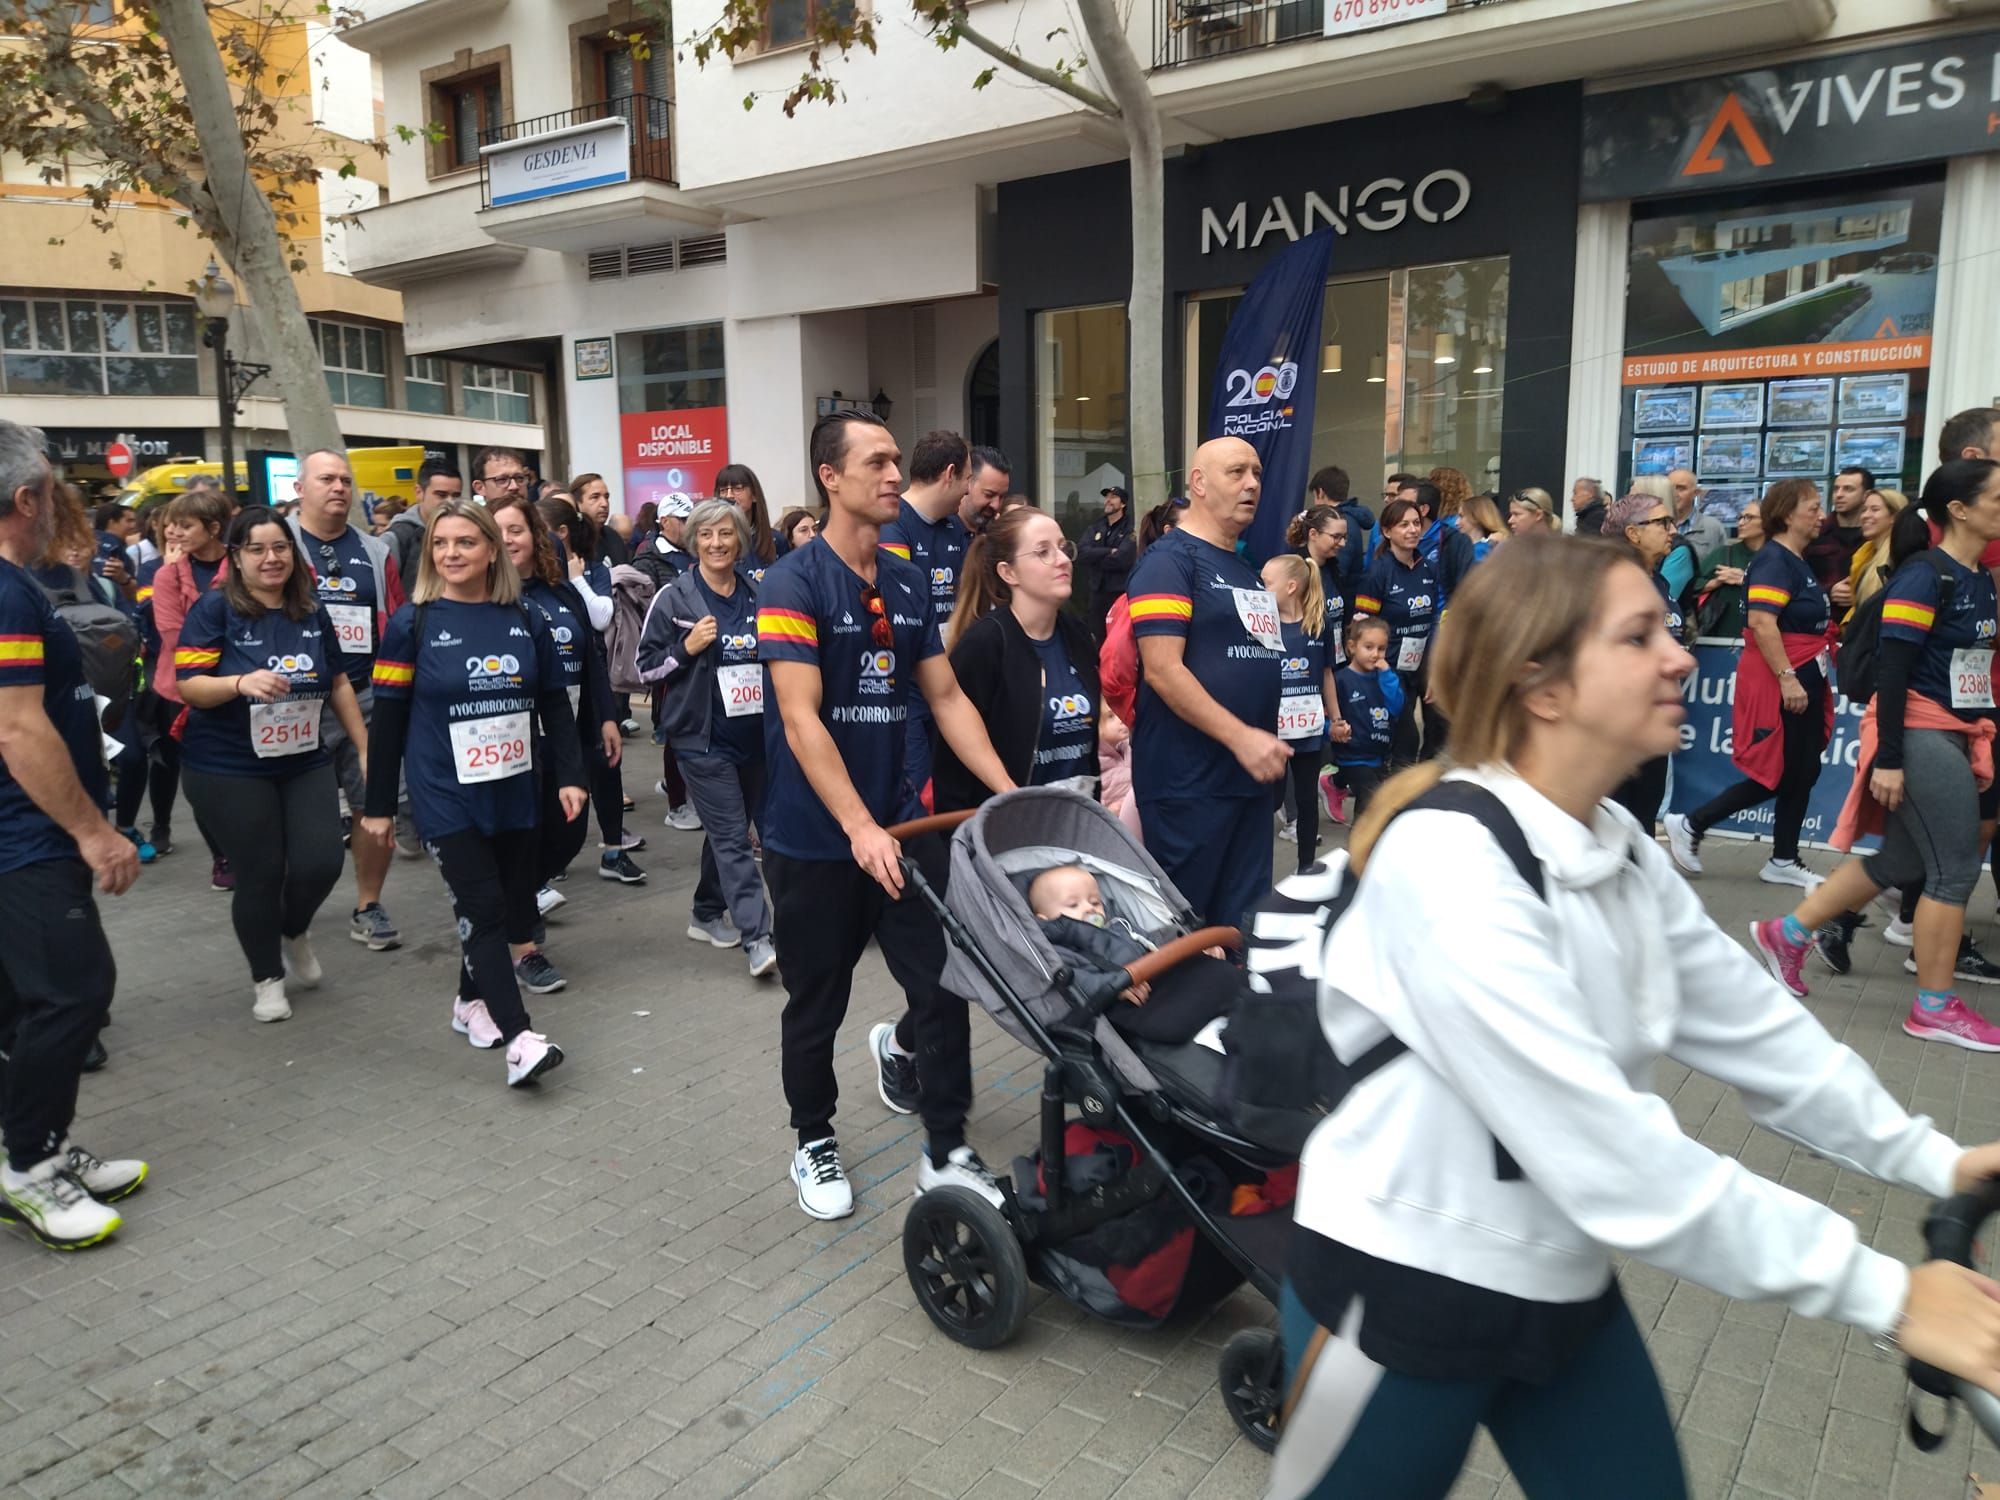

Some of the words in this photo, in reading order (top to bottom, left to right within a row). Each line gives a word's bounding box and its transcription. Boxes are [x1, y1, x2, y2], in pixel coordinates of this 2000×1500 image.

[1333, 1, 1363, 22] 670
[1766, 57, 1966, 135] VIVES
[524, 141, 596, 172] GESDENIA
[1201, 169, 1471, 255] MANGO
[1627, 361, 1677, 377] ESTUDIO
[1682, 359, 1698, 374] DE
[1702, 354, 1798, 374] ARQUITECTURA
[1803, 353, 1811, 366] Y
[1816, 344, 1922, 366] CONSTRUCCIÓN
[1226, 361, 1298, 407] 200
[651, 425, 692, 441] LOCAL
[638, 439, 711, 457] DISPONIBLE
[465, 654, 520, 679] 200
[1049, 693, 1091, 720] 200
[261, 721, 312, 744] 2514
[467, 739, 525, 768] 2529
